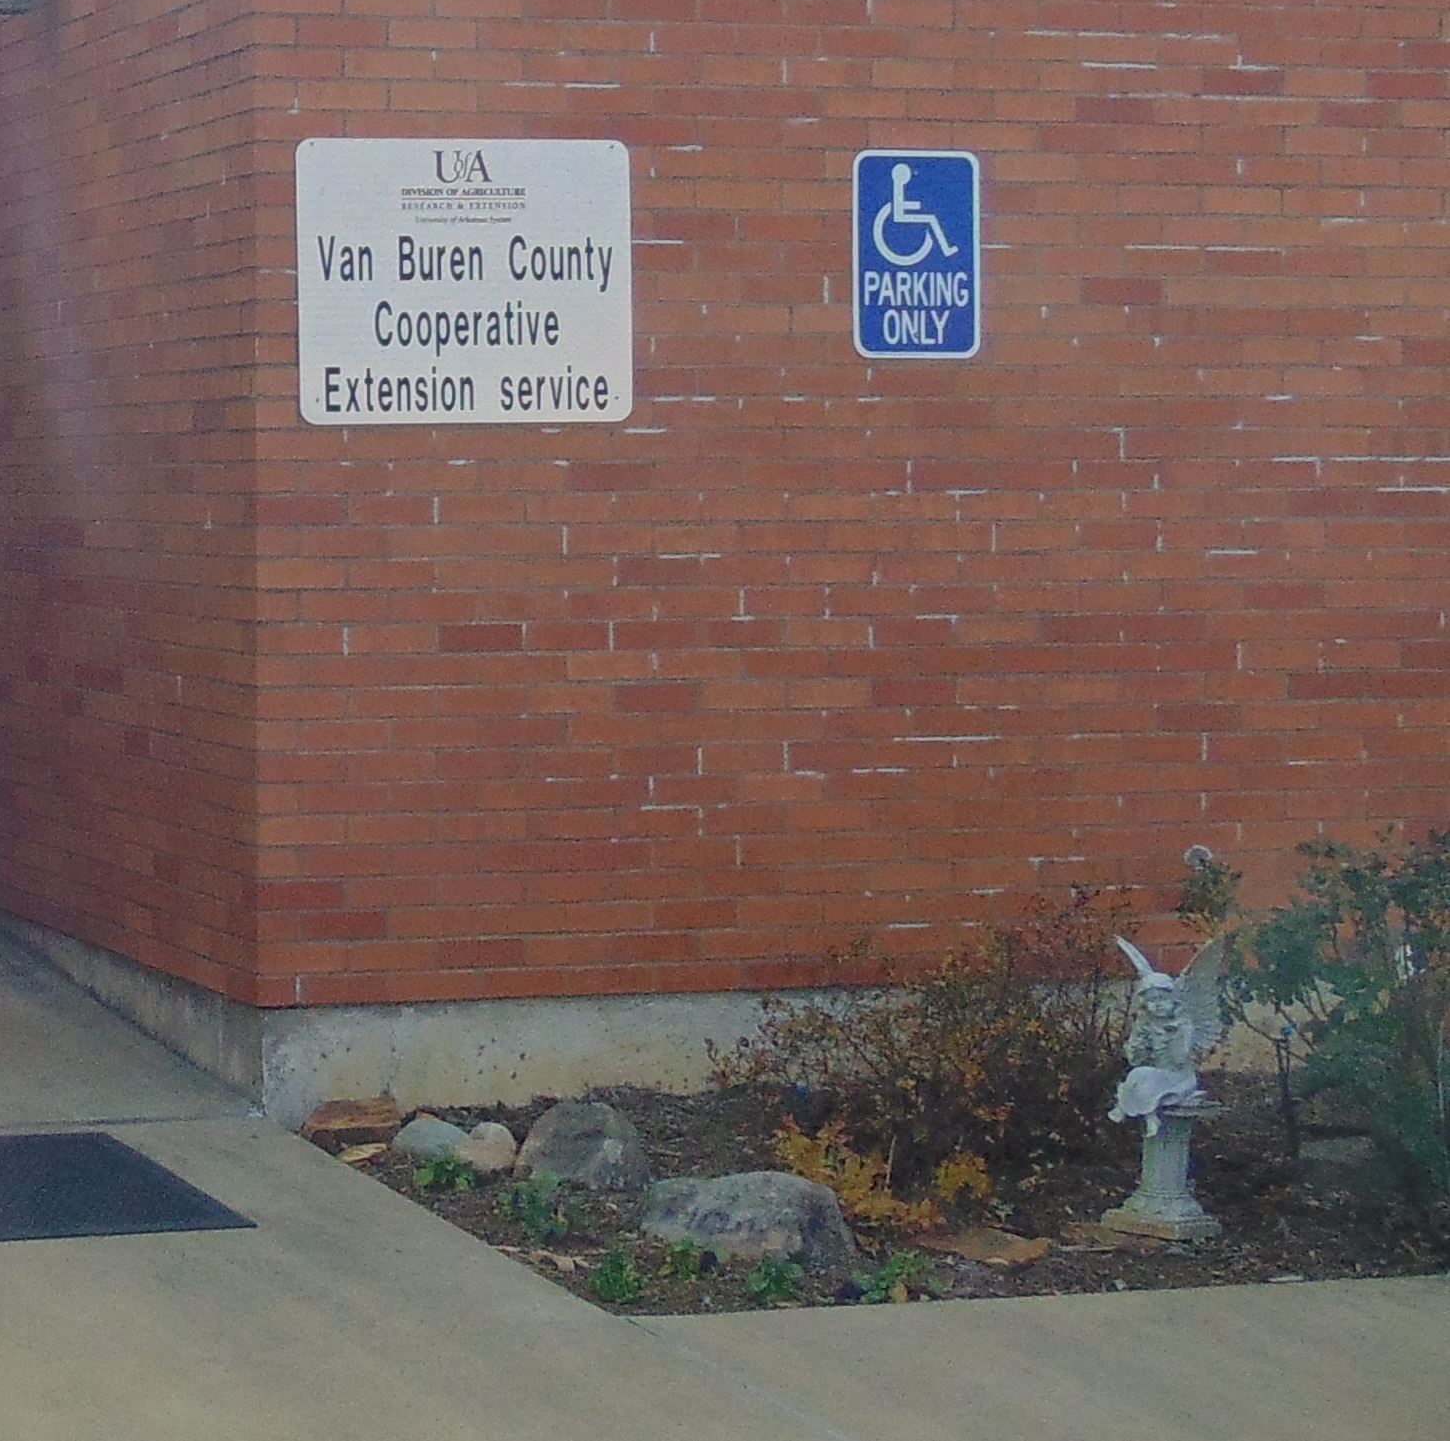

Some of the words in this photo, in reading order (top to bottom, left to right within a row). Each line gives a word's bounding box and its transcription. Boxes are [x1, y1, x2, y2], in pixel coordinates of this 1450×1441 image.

[401, 187, 443, 196] DIVISION
[446, 187, 458, 196] OF
[461, 187, 526, 196] AGRICULTURE
[469, 202, 526, 210] EXTENSION
[317, 236, 373, 281] Van
[399, 235, 483, 281] Buren
[509, 235, 613, 292] County
[864, 271, 969, 307] PARKING
[374, 300, 560, 357] Cooperative
[883, 310, 949, 345] ONLY
[325, 366, 475, 413] Extension
[500, 365, 609, 410] service
